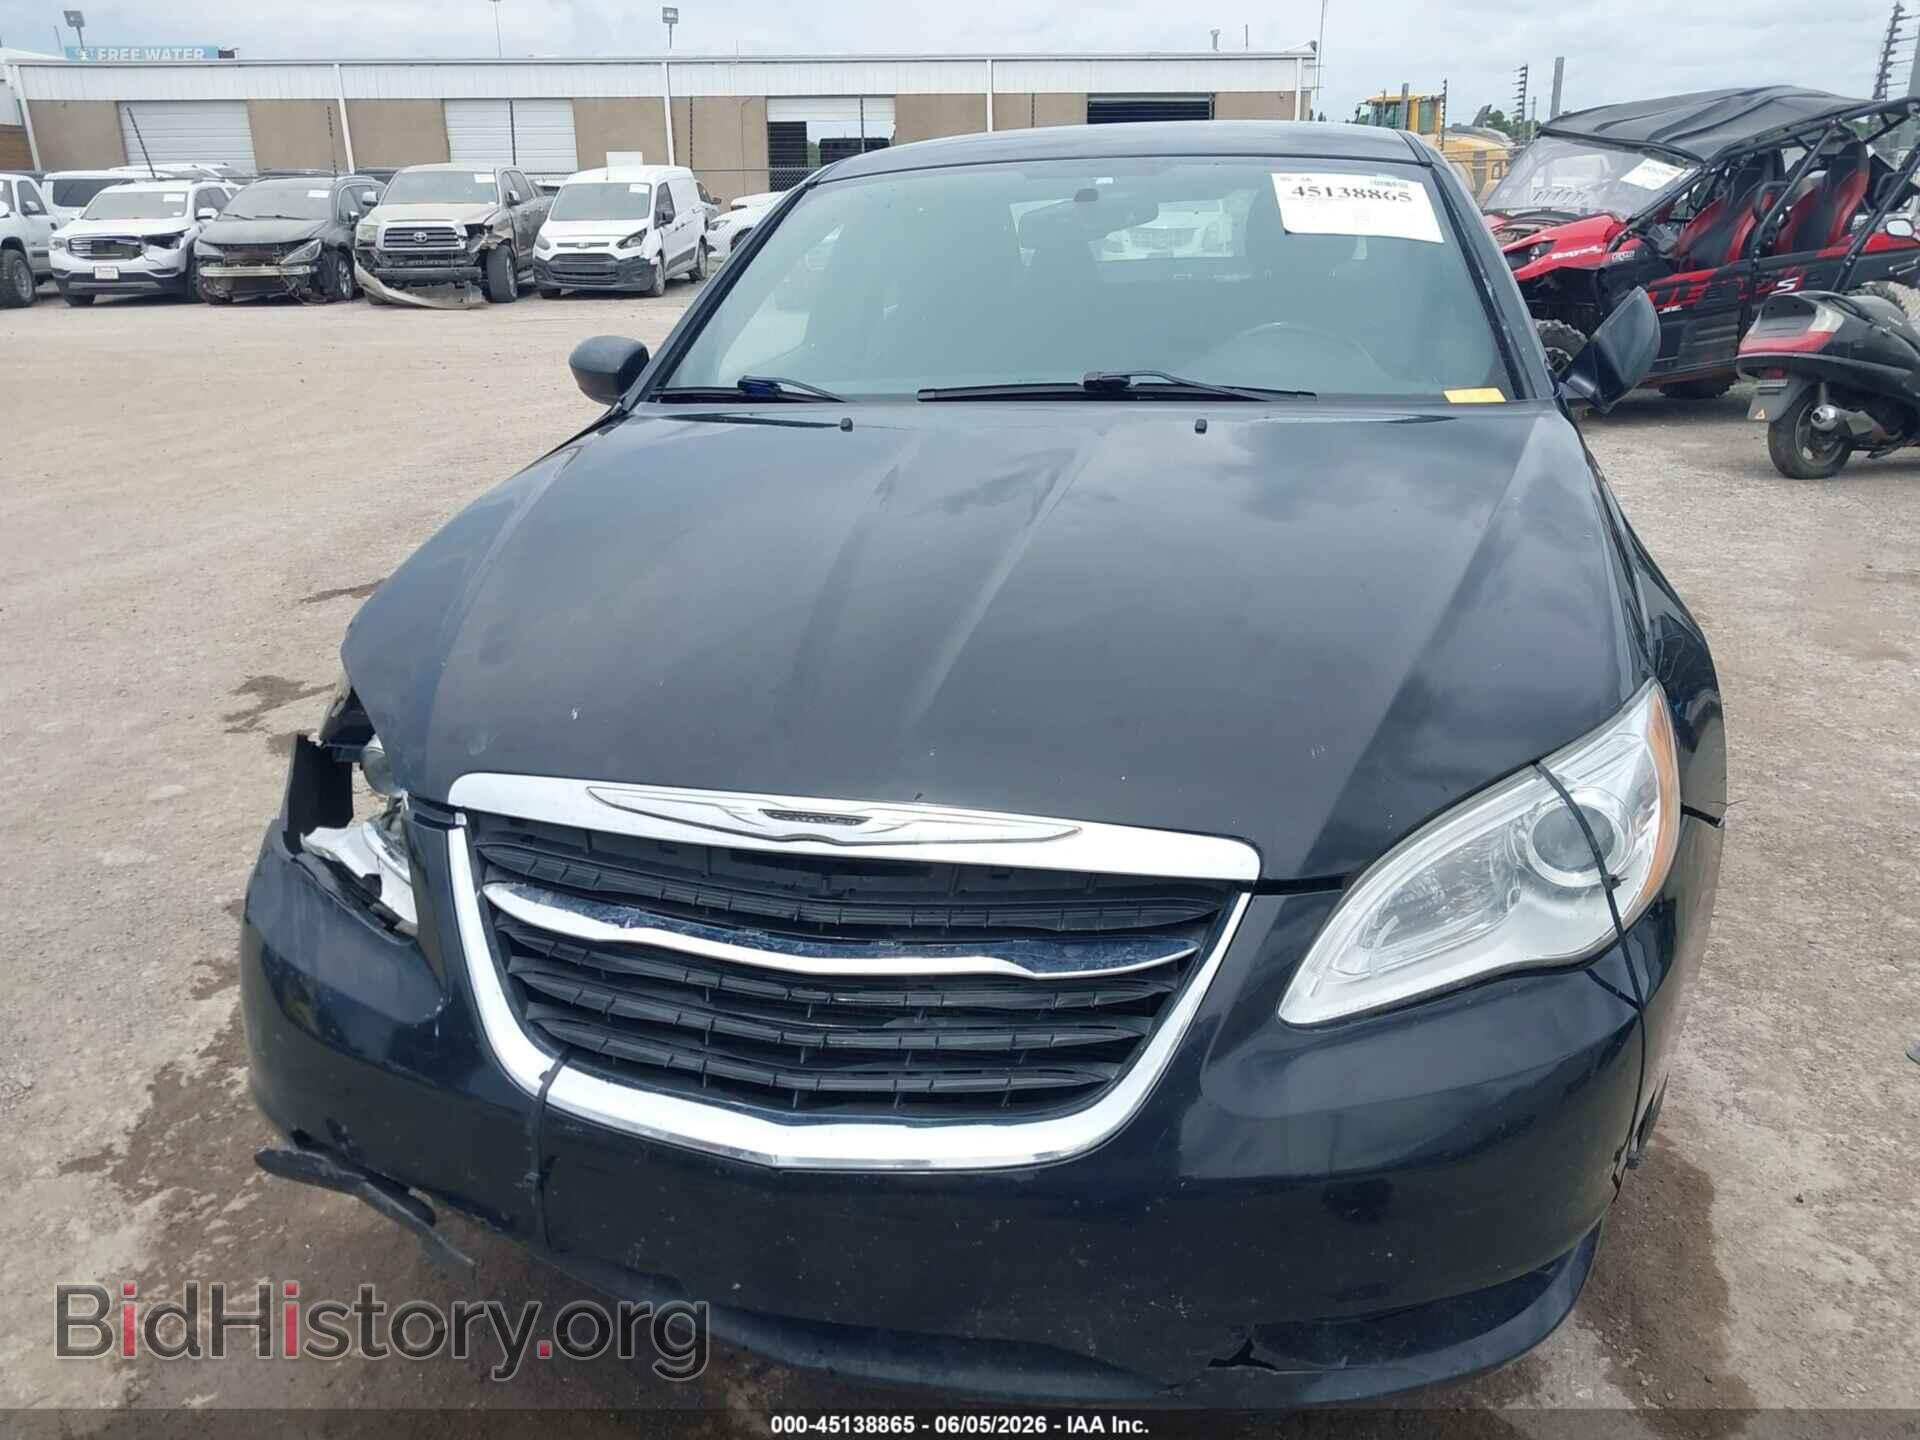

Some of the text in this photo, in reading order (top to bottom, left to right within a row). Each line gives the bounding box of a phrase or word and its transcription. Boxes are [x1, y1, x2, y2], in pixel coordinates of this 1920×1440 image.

[97, 47, 141, 60] FREE
[144, 47, 205, 60] WATER
[1291, 185, 1413, 203] 45138865
